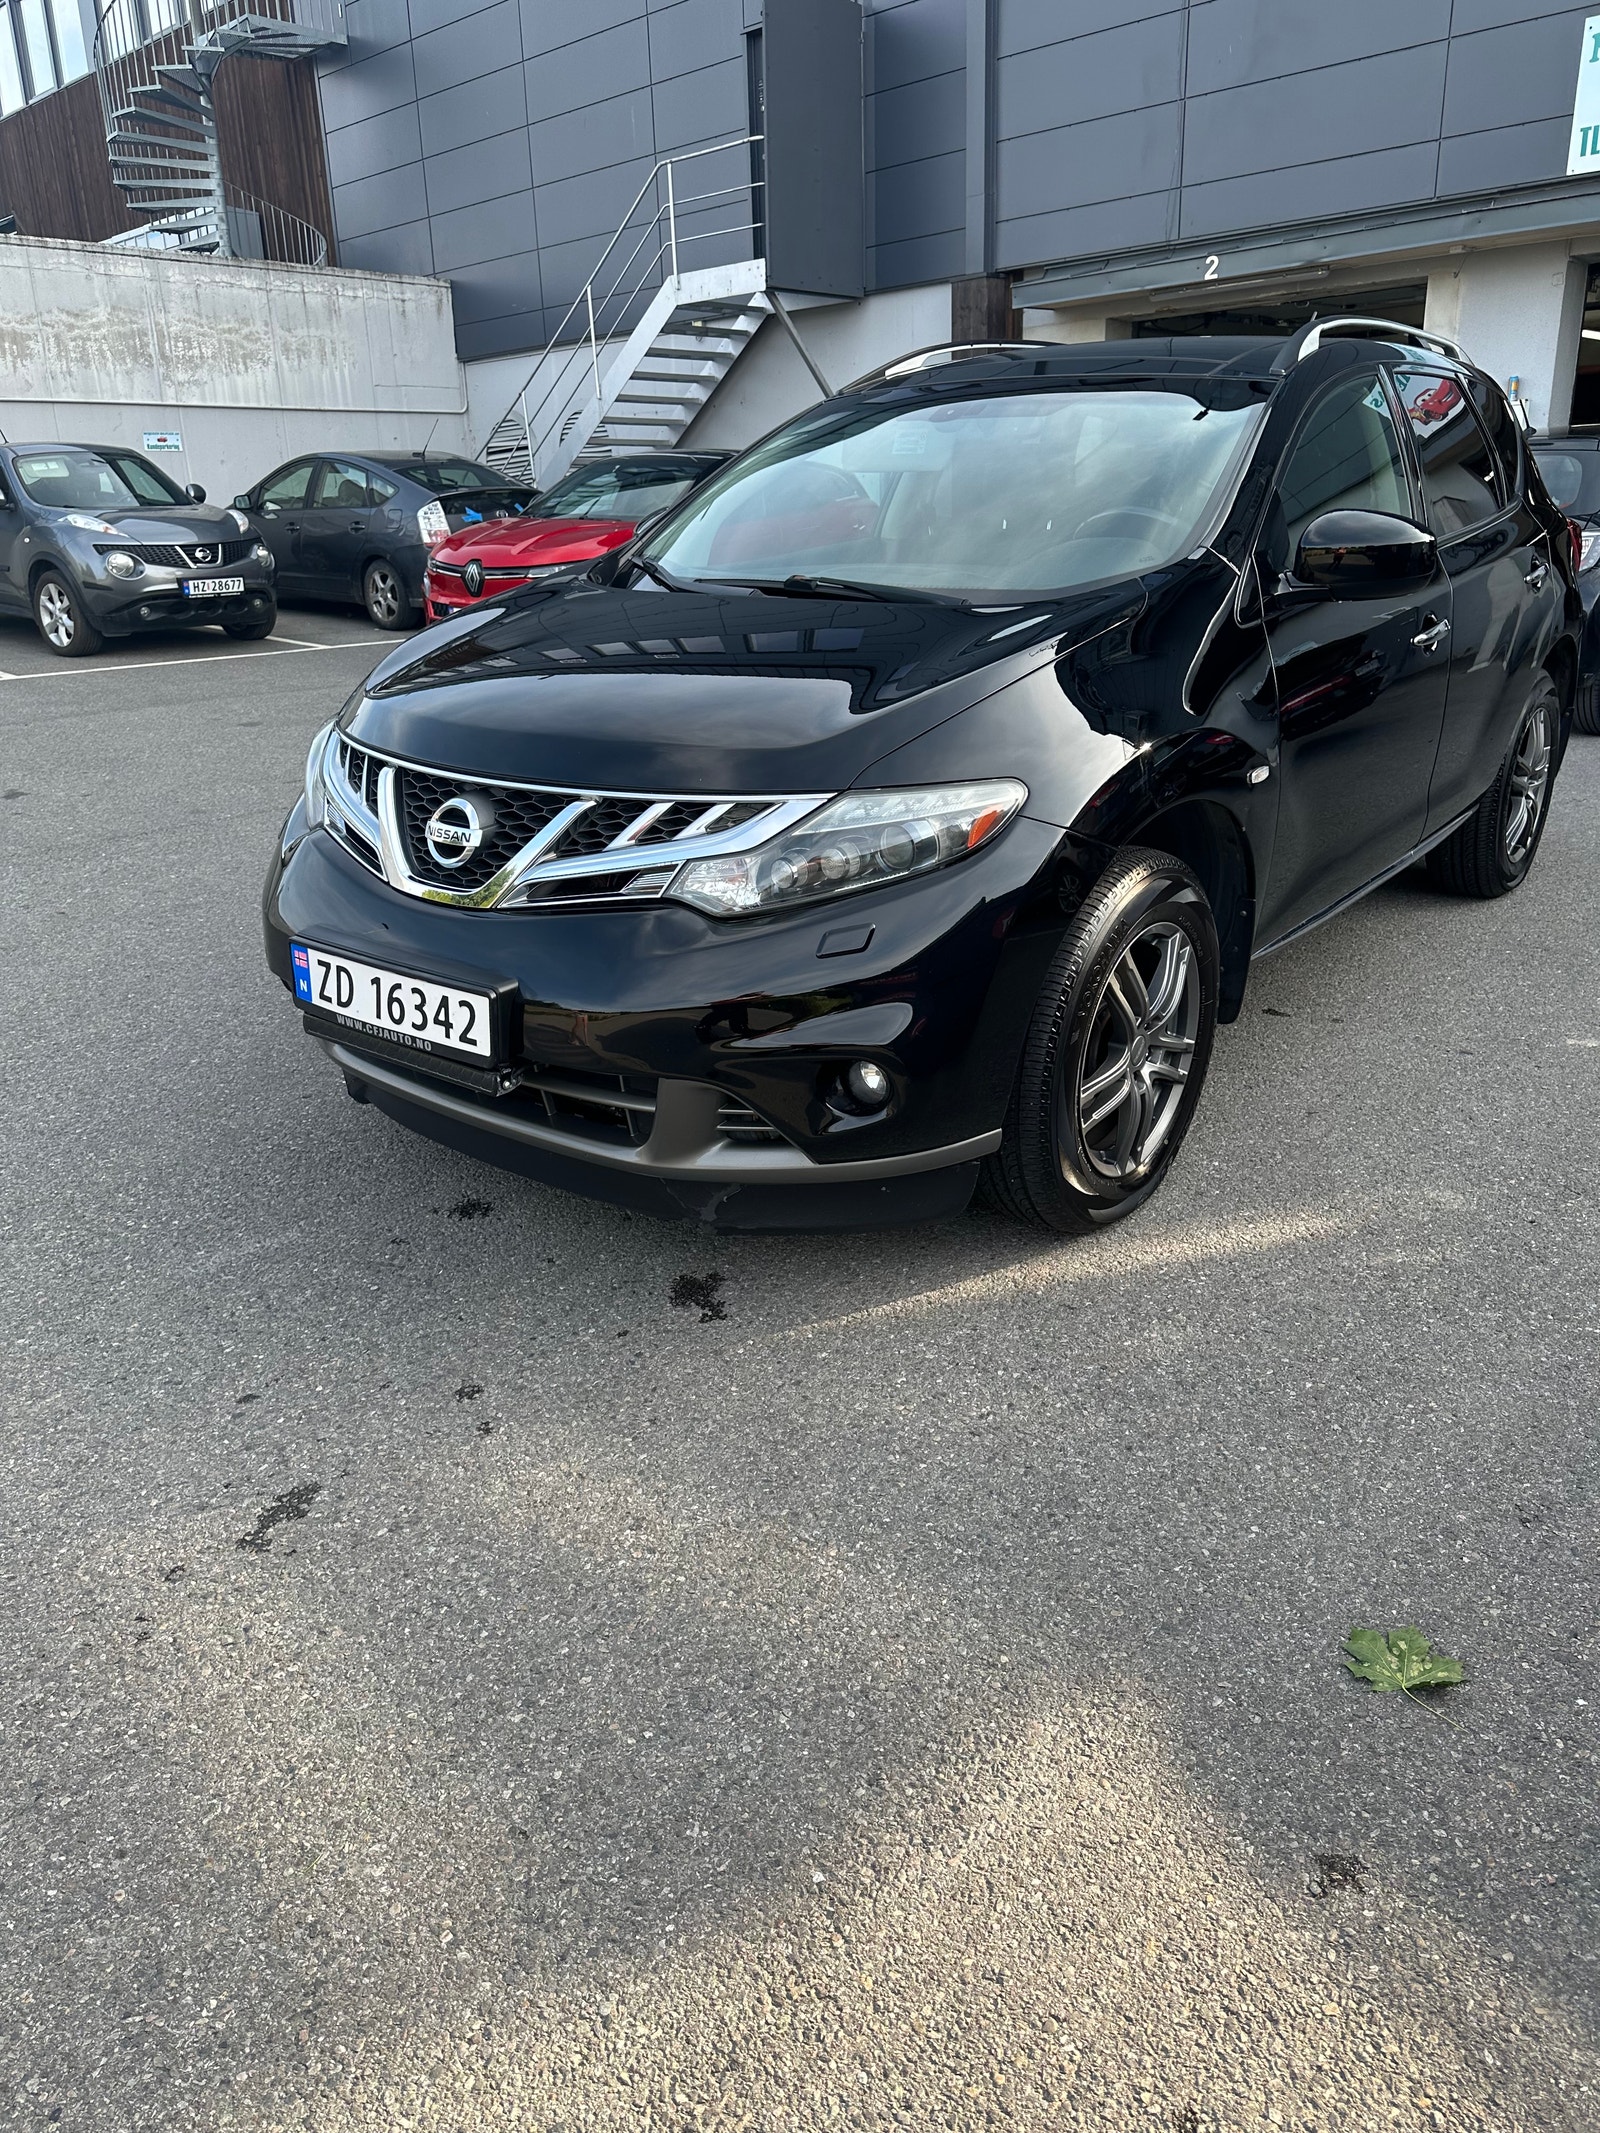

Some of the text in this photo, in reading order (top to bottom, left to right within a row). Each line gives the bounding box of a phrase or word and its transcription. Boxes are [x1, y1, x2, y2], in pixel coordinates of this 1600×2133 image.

[1204, 255, 1219, 280] 2
[192, 581, 206, 592] HZ
[211, 579, 241, 591] 28677
[427, 825, 472, 843] NISSAN
[299, 979, 308, 992] N
[317, 959, 478, 1047] ZD 16342
[336, 1014, 432, 1051] WWW.CFJAUTO.NO
